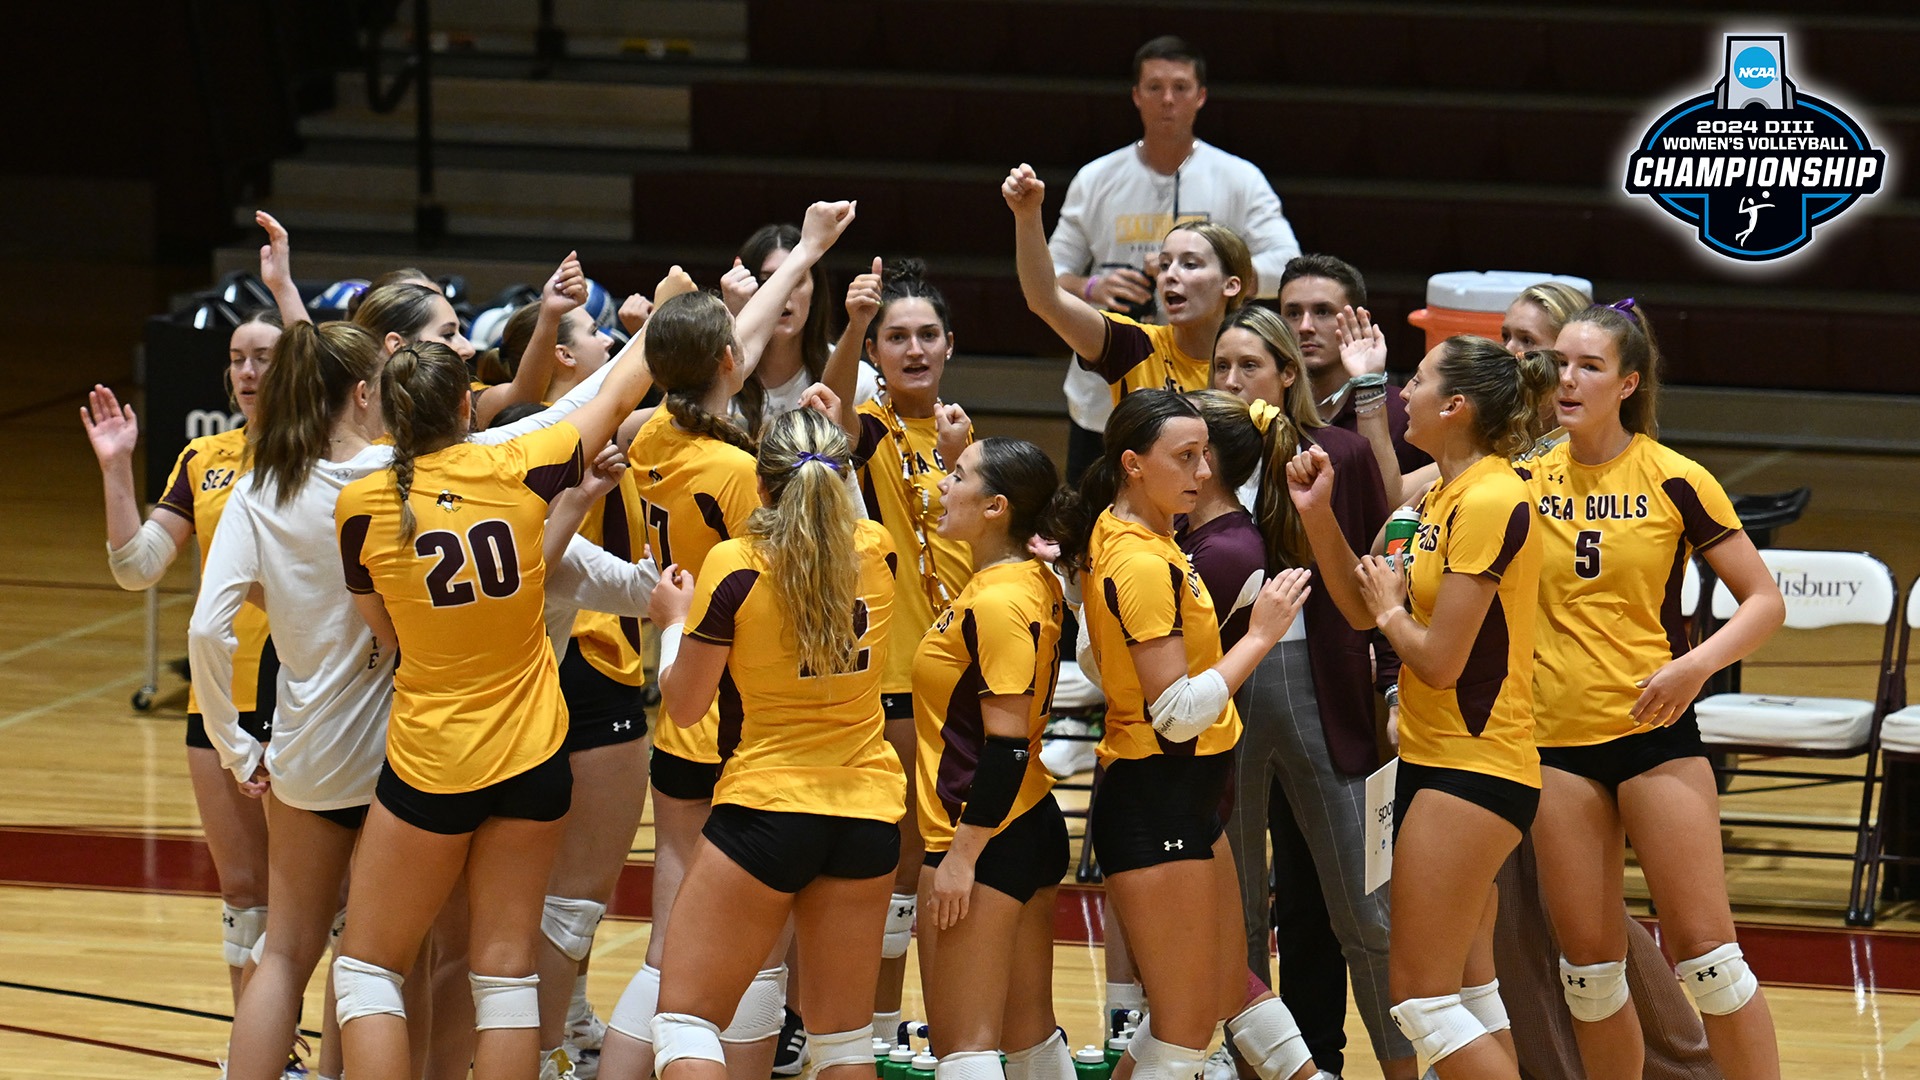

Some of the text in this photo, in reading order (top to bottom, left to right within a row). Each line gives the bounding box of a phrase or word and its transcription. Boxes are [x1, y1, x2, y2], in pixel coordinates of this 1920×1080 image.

[201, 467, 236, 492] SEA
[1538, 493, 1649, 521] SEA GULLS
[414, 517, 521, 609] 20
[1574, 530, 1603, 580] 5
[1776, 572, 1862, 606] lisbury
